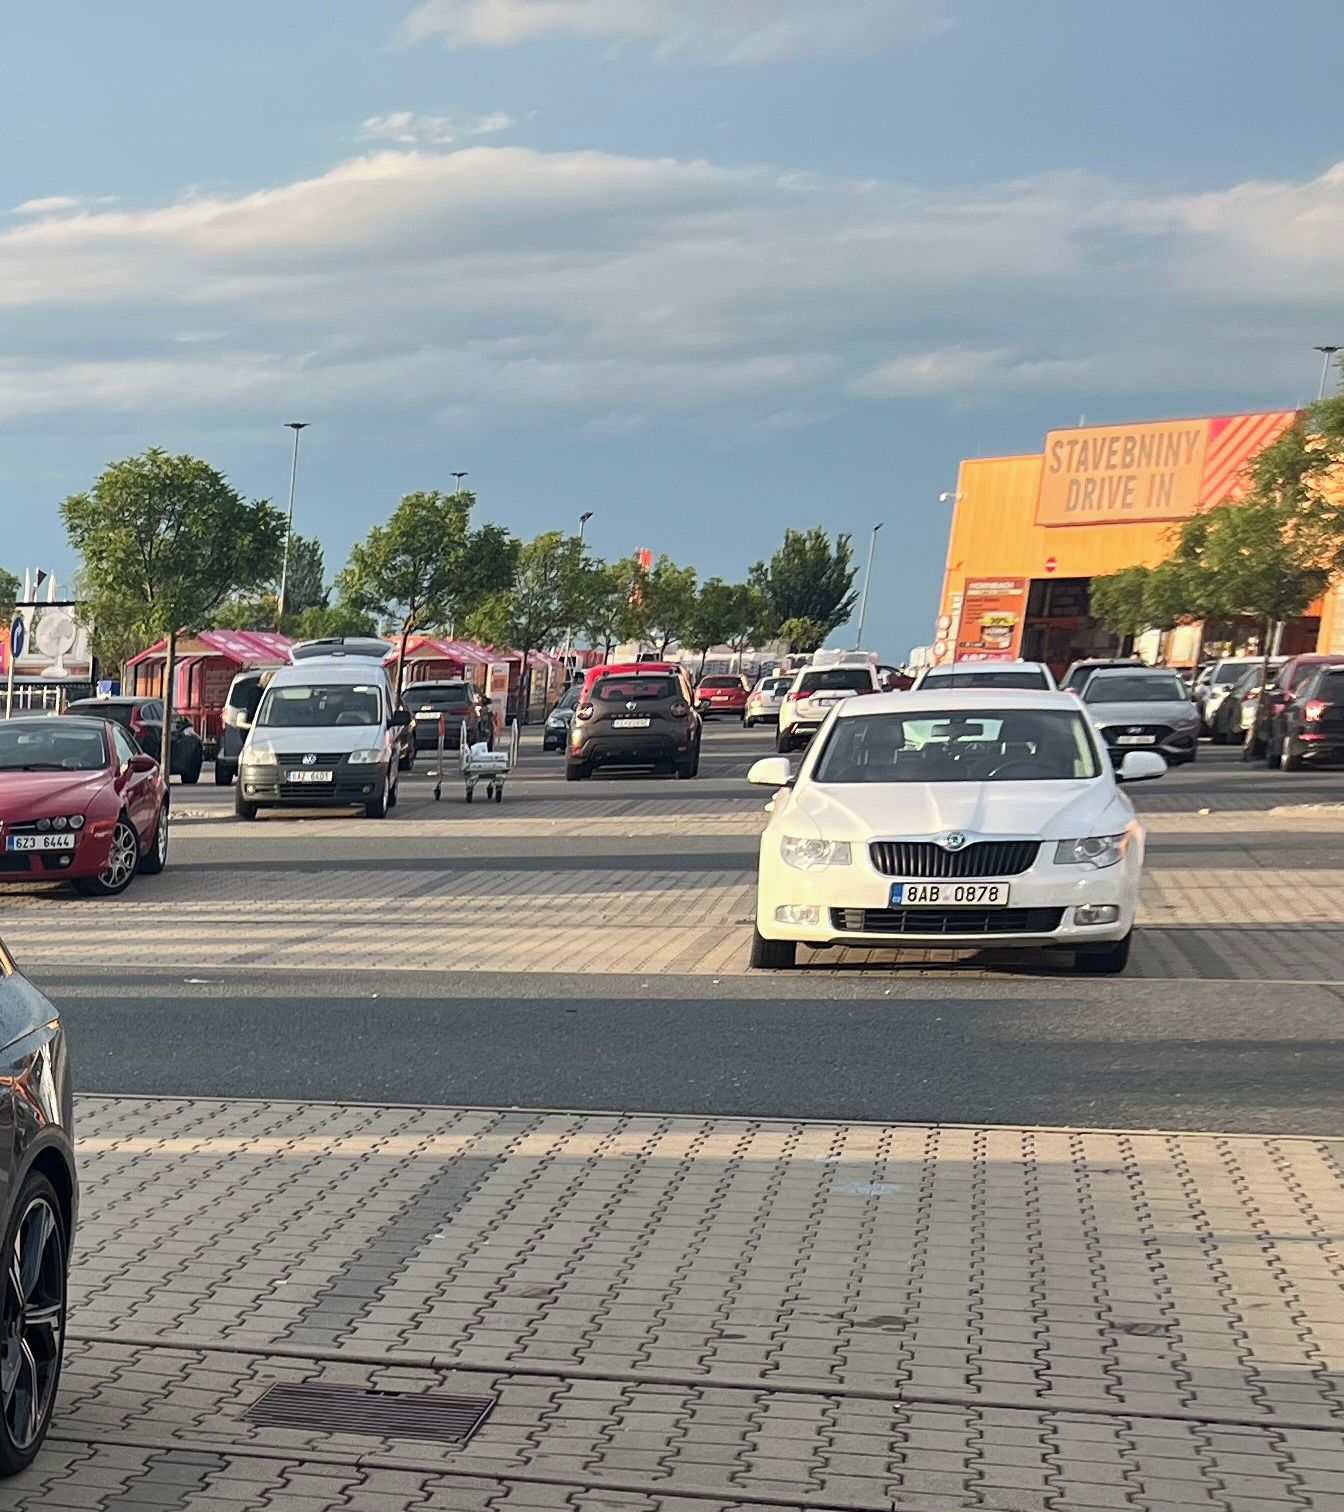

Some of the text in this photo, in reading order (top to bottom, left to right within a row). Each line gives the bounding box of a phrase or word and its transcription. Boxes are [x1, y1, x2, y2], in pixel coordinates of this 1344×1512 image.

[1050, 430, 1201, 474] STAVEBNINY
[1066, 472, 1175, 512] DRIVE IN
[43, 836, 70, 848] 6444
[907, 886, 999, 902] 8AB 0878
